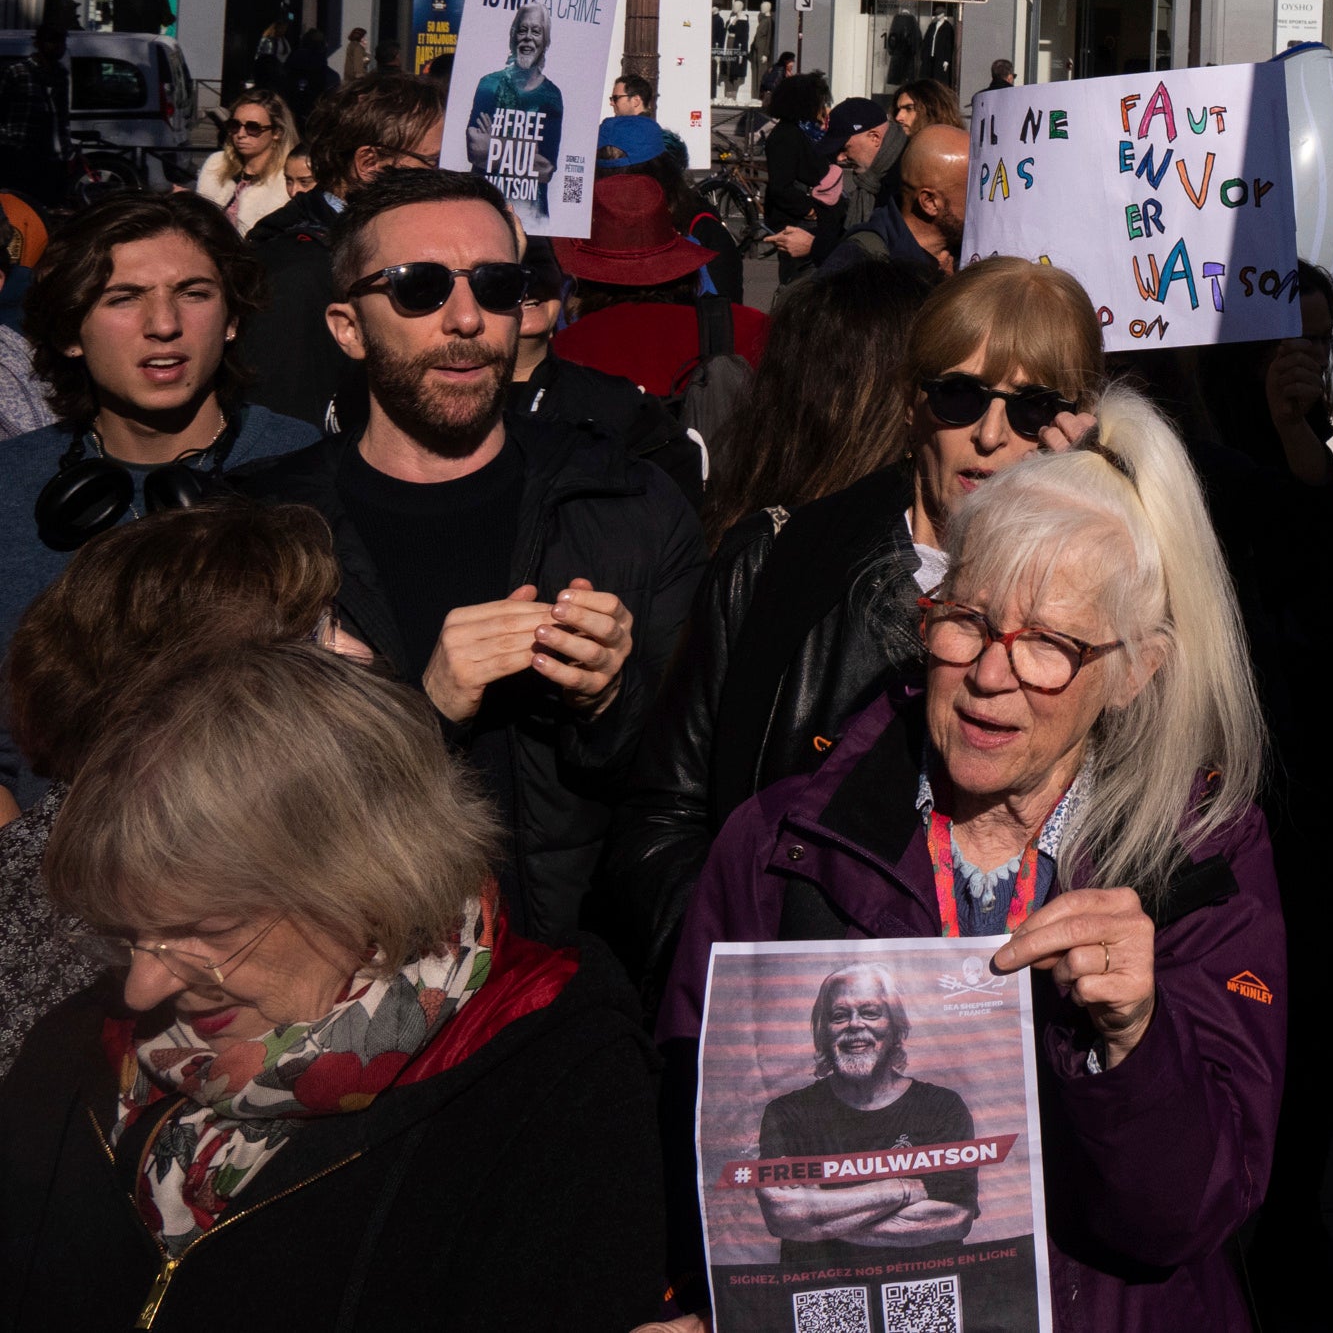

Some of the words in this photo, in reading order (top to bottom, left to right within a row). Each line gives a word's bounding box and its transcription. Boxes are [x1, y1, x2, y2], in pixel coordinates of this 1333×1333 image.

[1281, 2, 1313, 11] OYSHO
[427, 20, 435, 32] 50
[436, 21, 450, 33] ANS
[490, 107, 547, 142] #FREE
[1019, 106, 1069, 144] NE
[1120, 81, 1227, 143] FAUT
[486, 137, 540, 178] PAUL
[979, 157, 1035, 202] PAS
[1124, 197, 1165, 240] ER
[1133, 237, 1300, 313] WATSON
[959, 1008, 992, 1017] FRANCE
[960, 1000, 1004, 1010] SHEPHERD
[729, 1275, 780, 1285] SIGNEZ,
[782, 1268, 852, 1284] PARTAGEZ
[855, 1265, 883, 1276] NOS
[886, 1257, 955, 1274] PÉTITIONS
[957, 1254, 976, 1265] EN
[979, 1247, 1018, 1261] LIGNE
